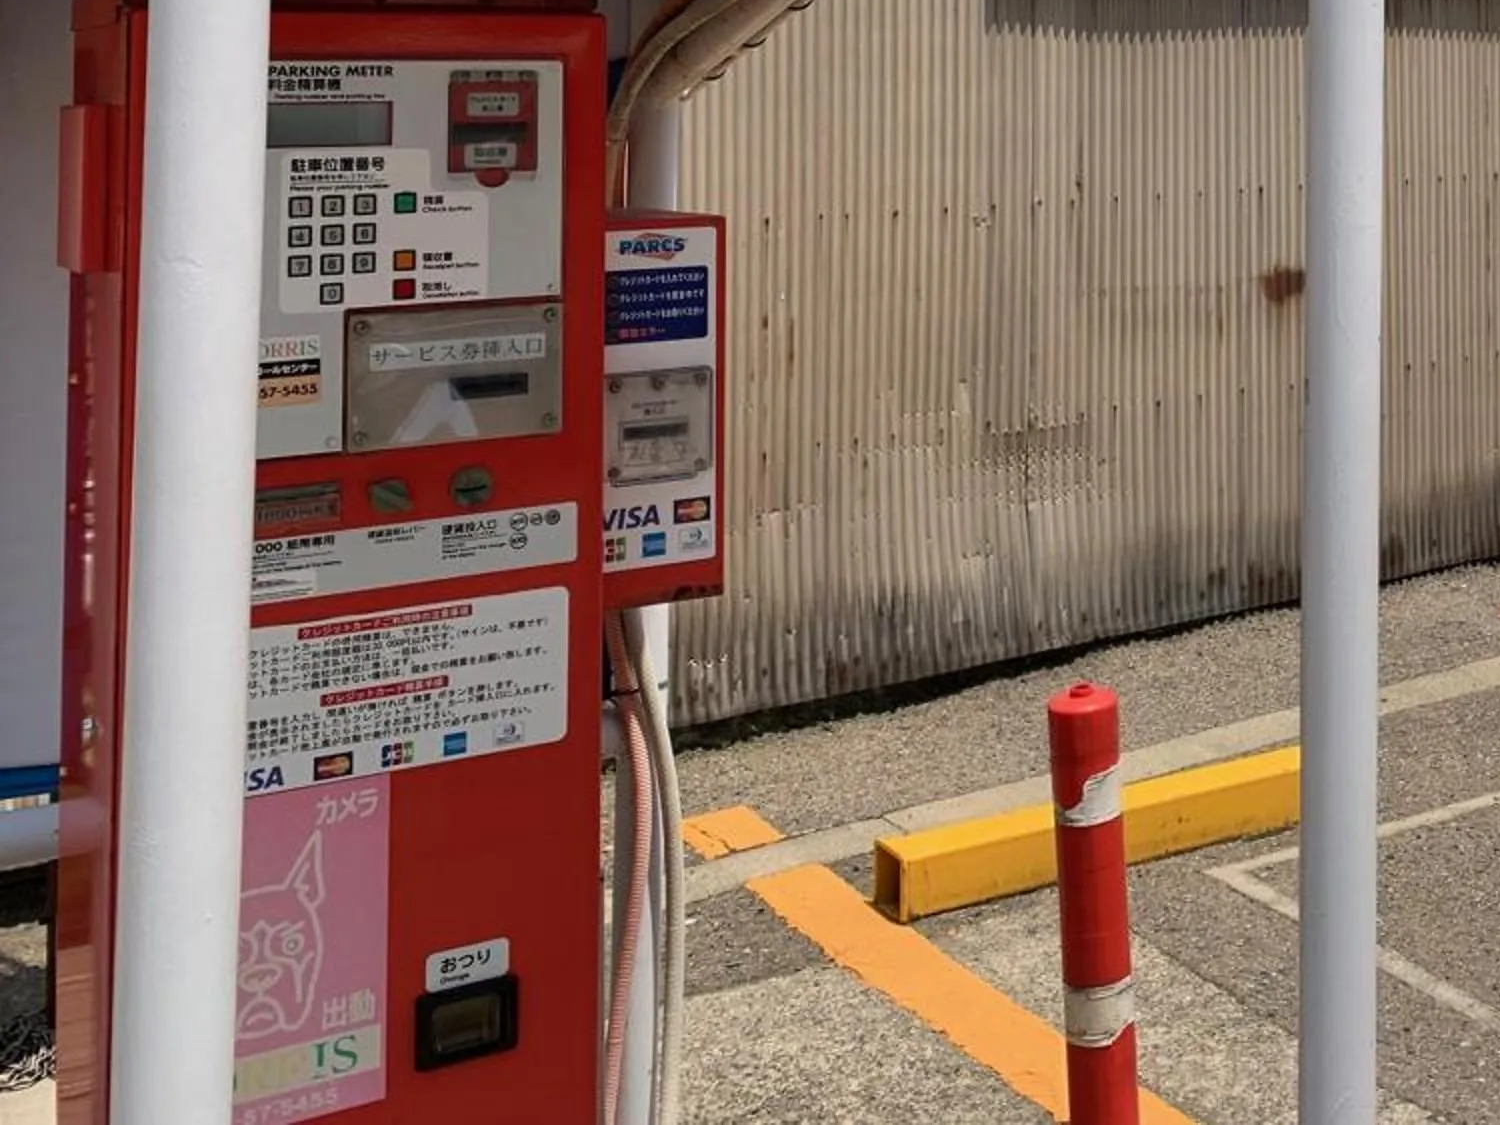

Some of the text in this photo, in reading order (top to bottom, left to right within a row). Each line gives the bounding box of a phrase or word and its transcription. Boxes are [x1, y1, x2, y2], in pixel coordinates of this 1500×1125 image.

[268, 65, 393, 78] PARKING METER
[291, 157, 385, 173] 駐車位置番号
[619, 237, 687, 256] PARCS
[602, 504, 660, 531] VISA
[316, 787, 380, 825] カメラ
[440, 948, 492, 974] おつり
